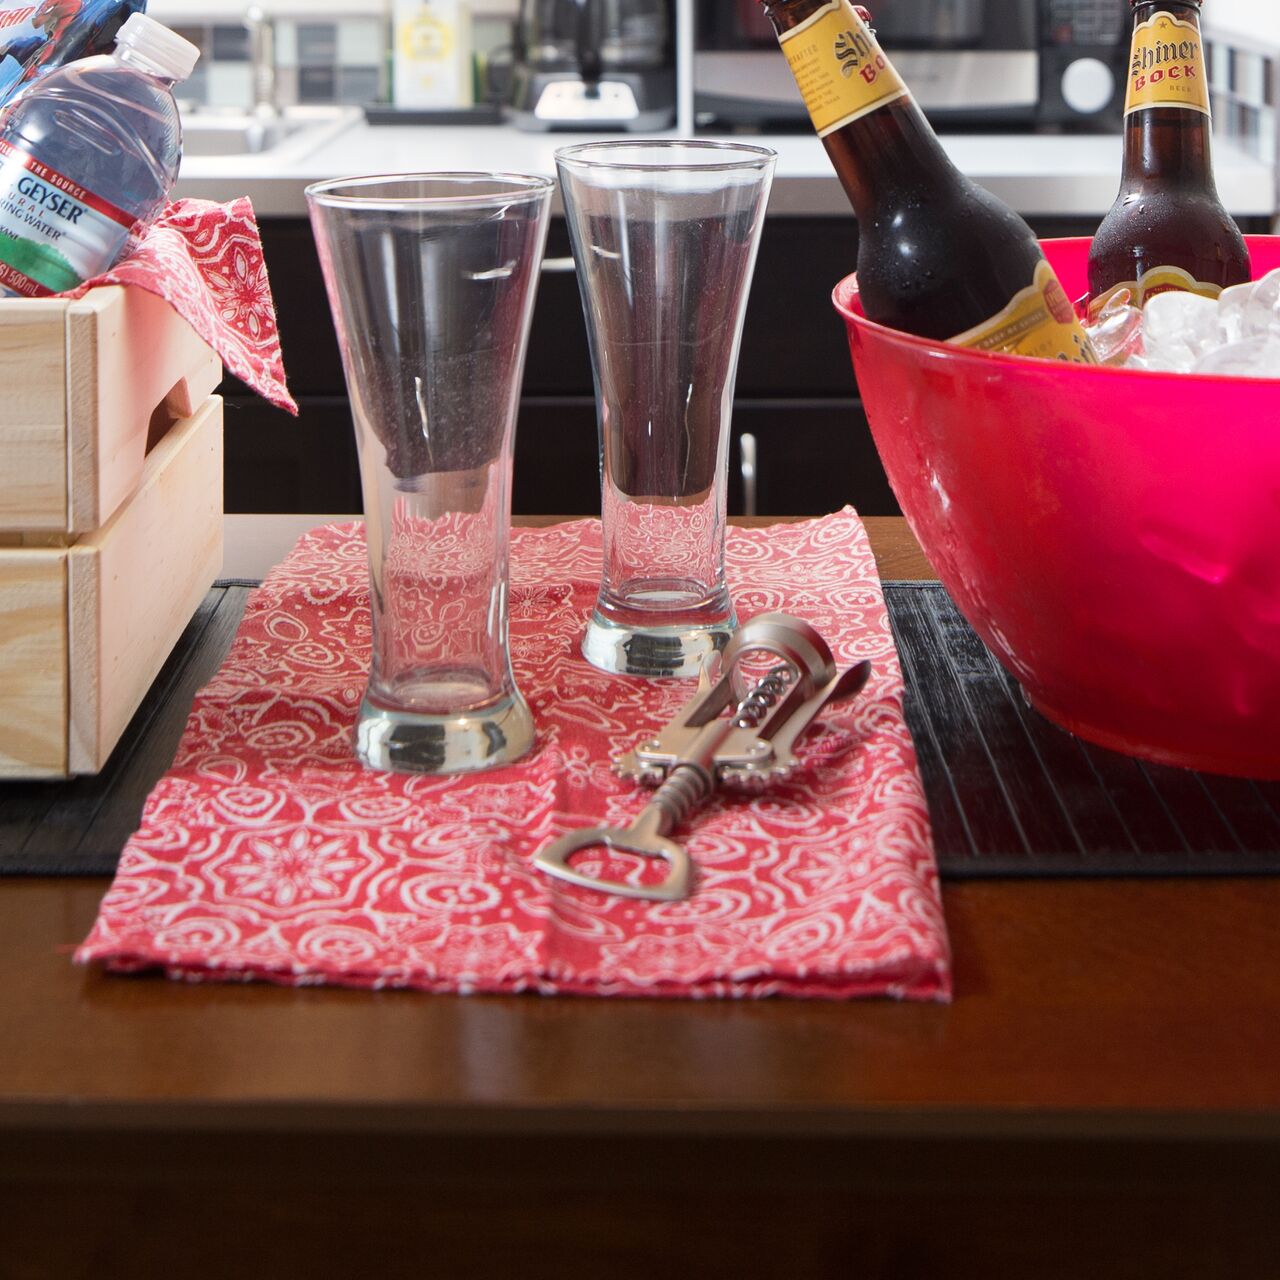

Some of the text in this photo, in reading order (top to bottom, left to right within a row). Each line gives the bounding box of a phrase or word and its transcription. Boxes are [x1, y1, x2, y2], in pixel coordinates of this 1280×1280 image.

[1131, 40, 1199, 76] Shiner
[1135, 65, 1196, 91] BOCK
[30, 161, 47, 177] THE
[51, 174, 87, 200] SOURCE
[18, 177, 84, 225] GEYSER
[24, 213, 62, 241] WATER
[8, 271, 41, 297] 500mL
